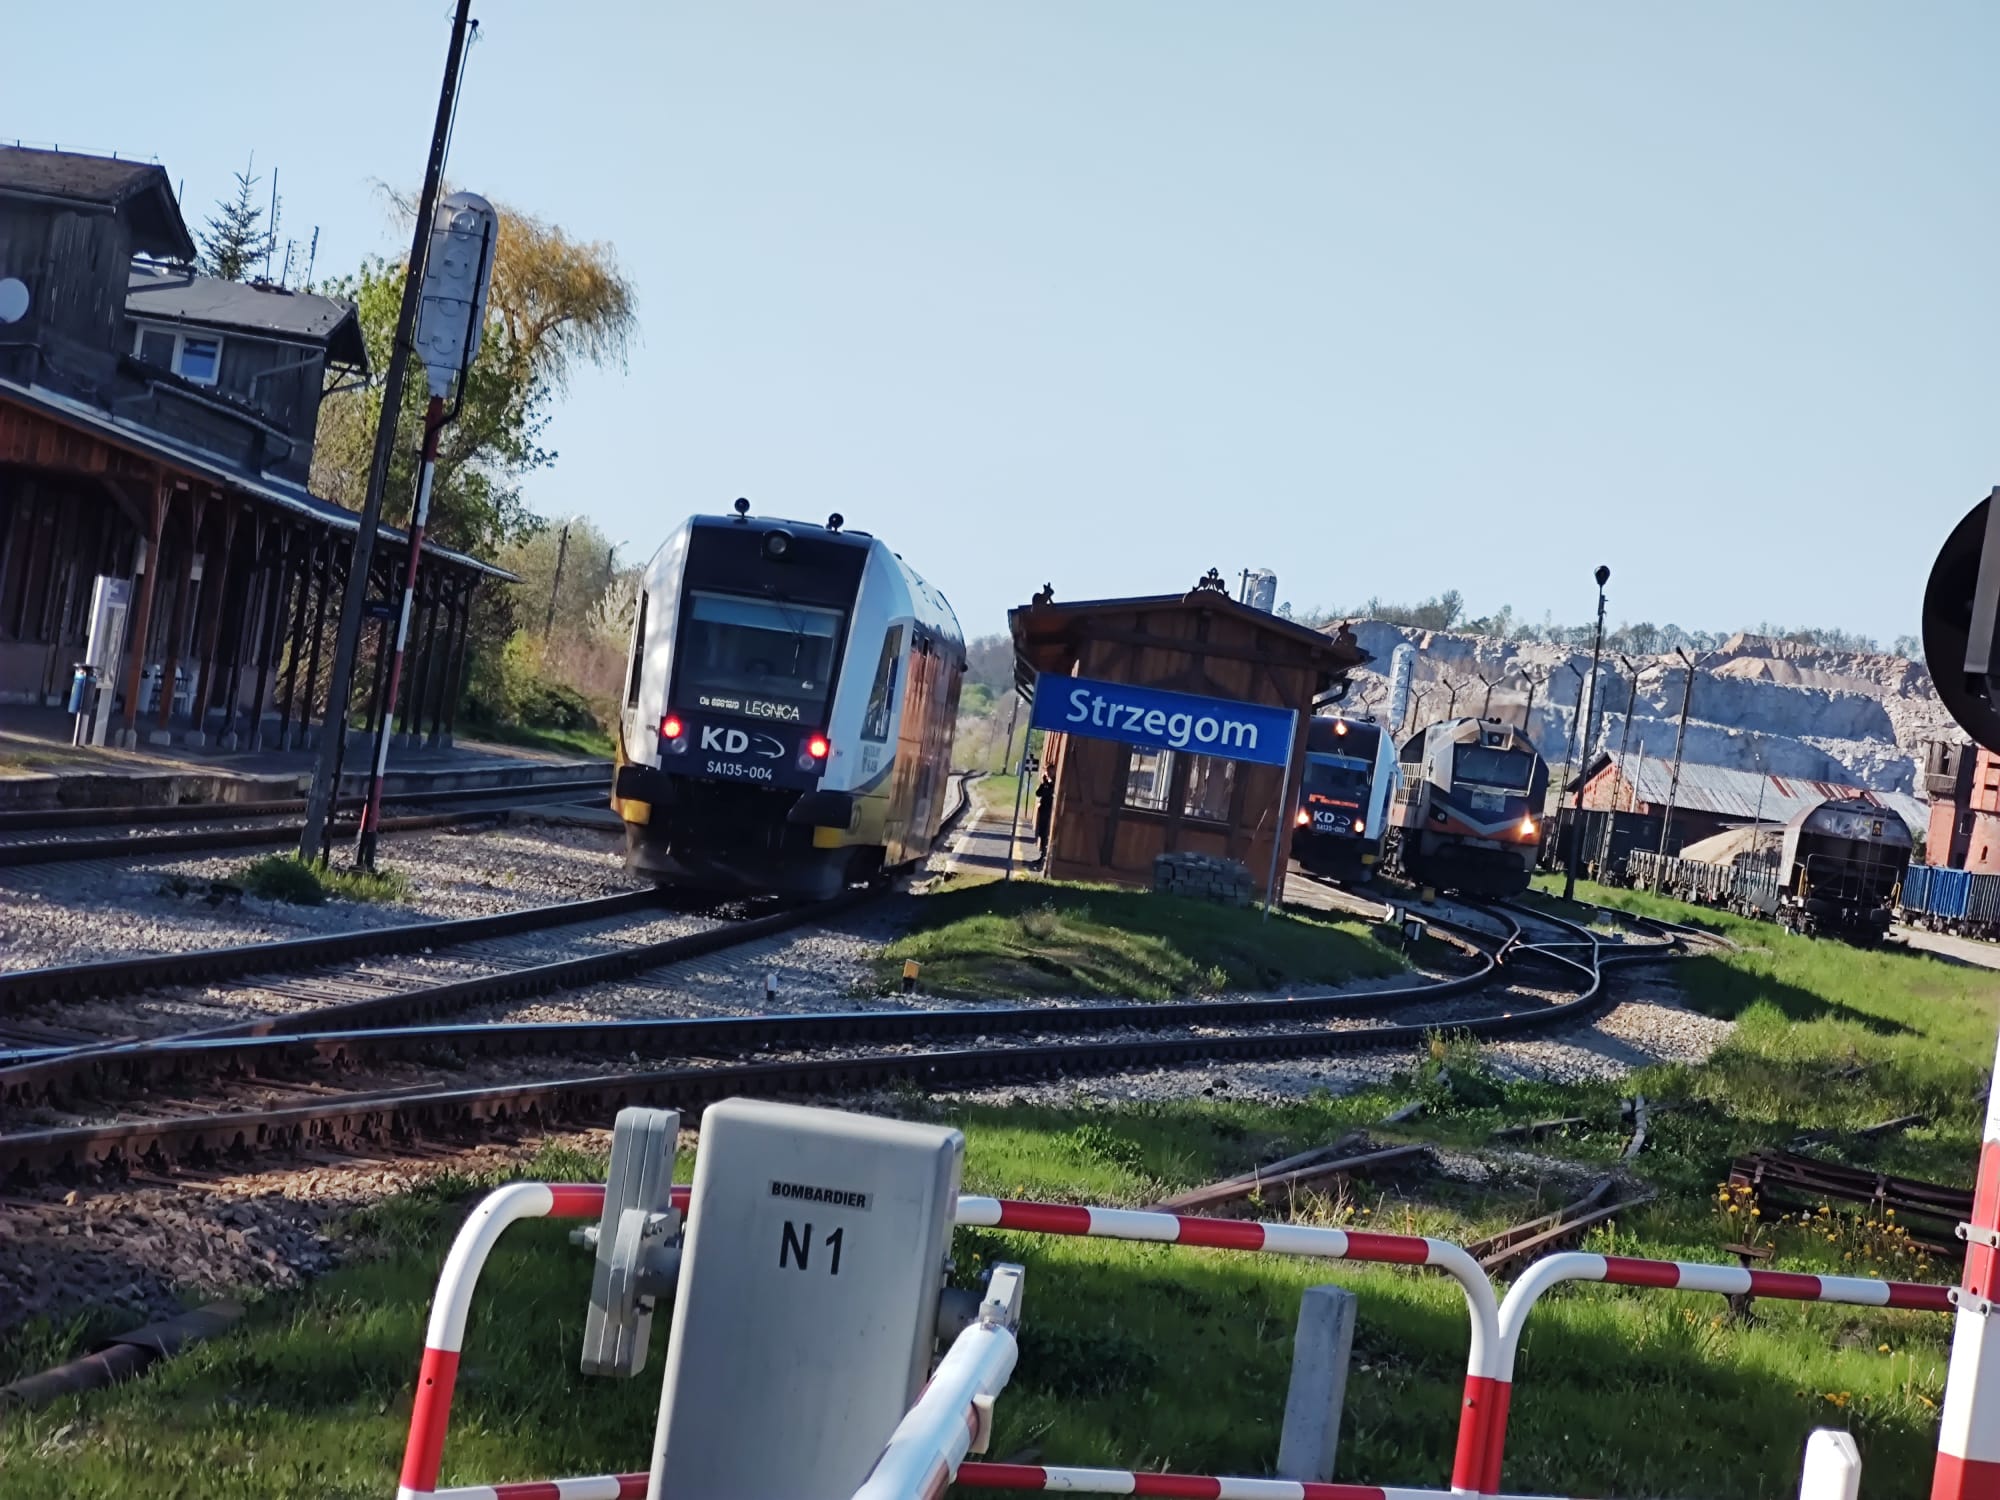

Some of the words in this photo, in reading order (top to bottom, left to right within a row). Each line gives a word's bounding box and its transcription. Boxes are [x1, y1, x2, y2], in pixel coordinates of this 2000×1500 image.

[744, 700, 800, 721] LEGNICA
[1065, 689, 1259, 749] Strzegom
[700, 726, 749, 754] KD
[706, 760, 773, 781] SA135-004
[1313, 810, 1336, 824] KD
[771, 1181, 867, 1209] BOMBARDIER
[779, 1220, 812, 1271] N
[825, 1226, 844, 1275] 1
